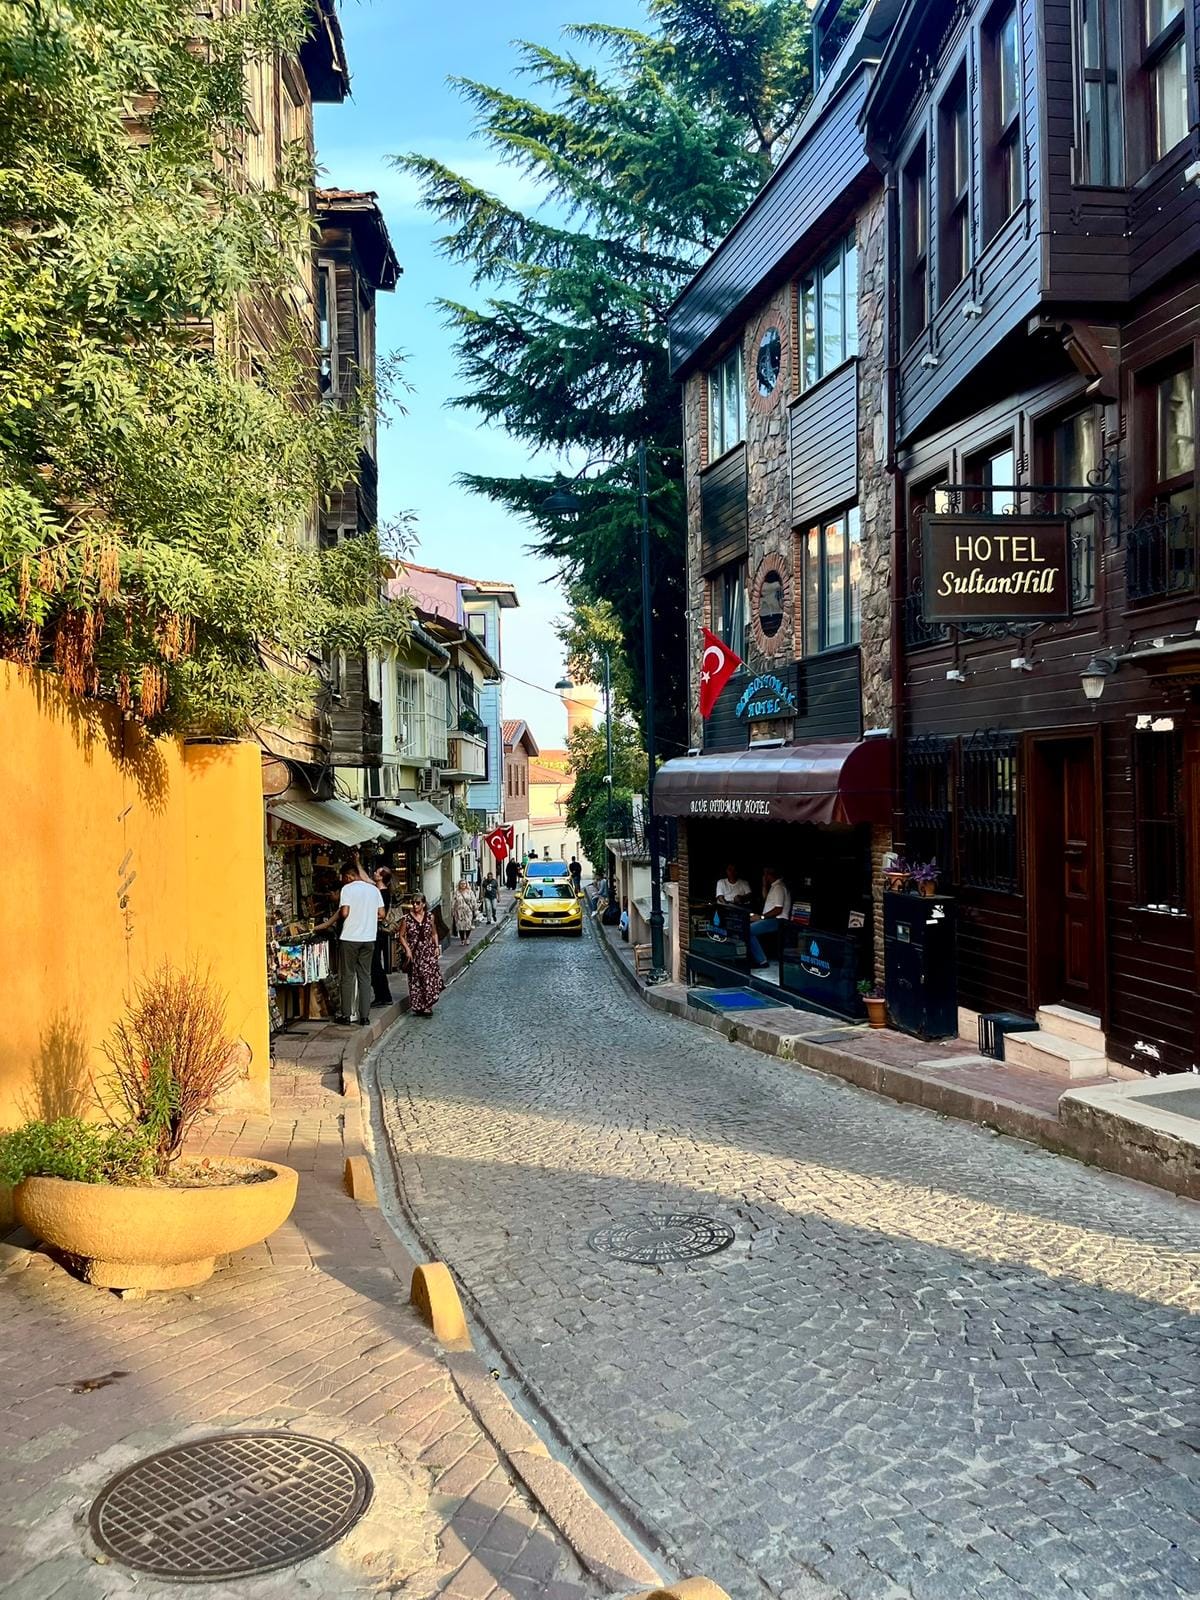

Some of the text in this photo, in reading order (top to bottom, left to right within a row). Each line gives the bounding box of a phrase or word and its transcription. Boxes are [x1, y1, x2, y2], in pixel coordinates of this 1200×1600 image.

[955, 535, 1046, 563] HOTEL
[747, 697, 781, 718] HOTEL
[690, 798, 770, 815] BLUE OTTOMAN HOTEL
[162, 1467, 291, 1532] TELEFON
